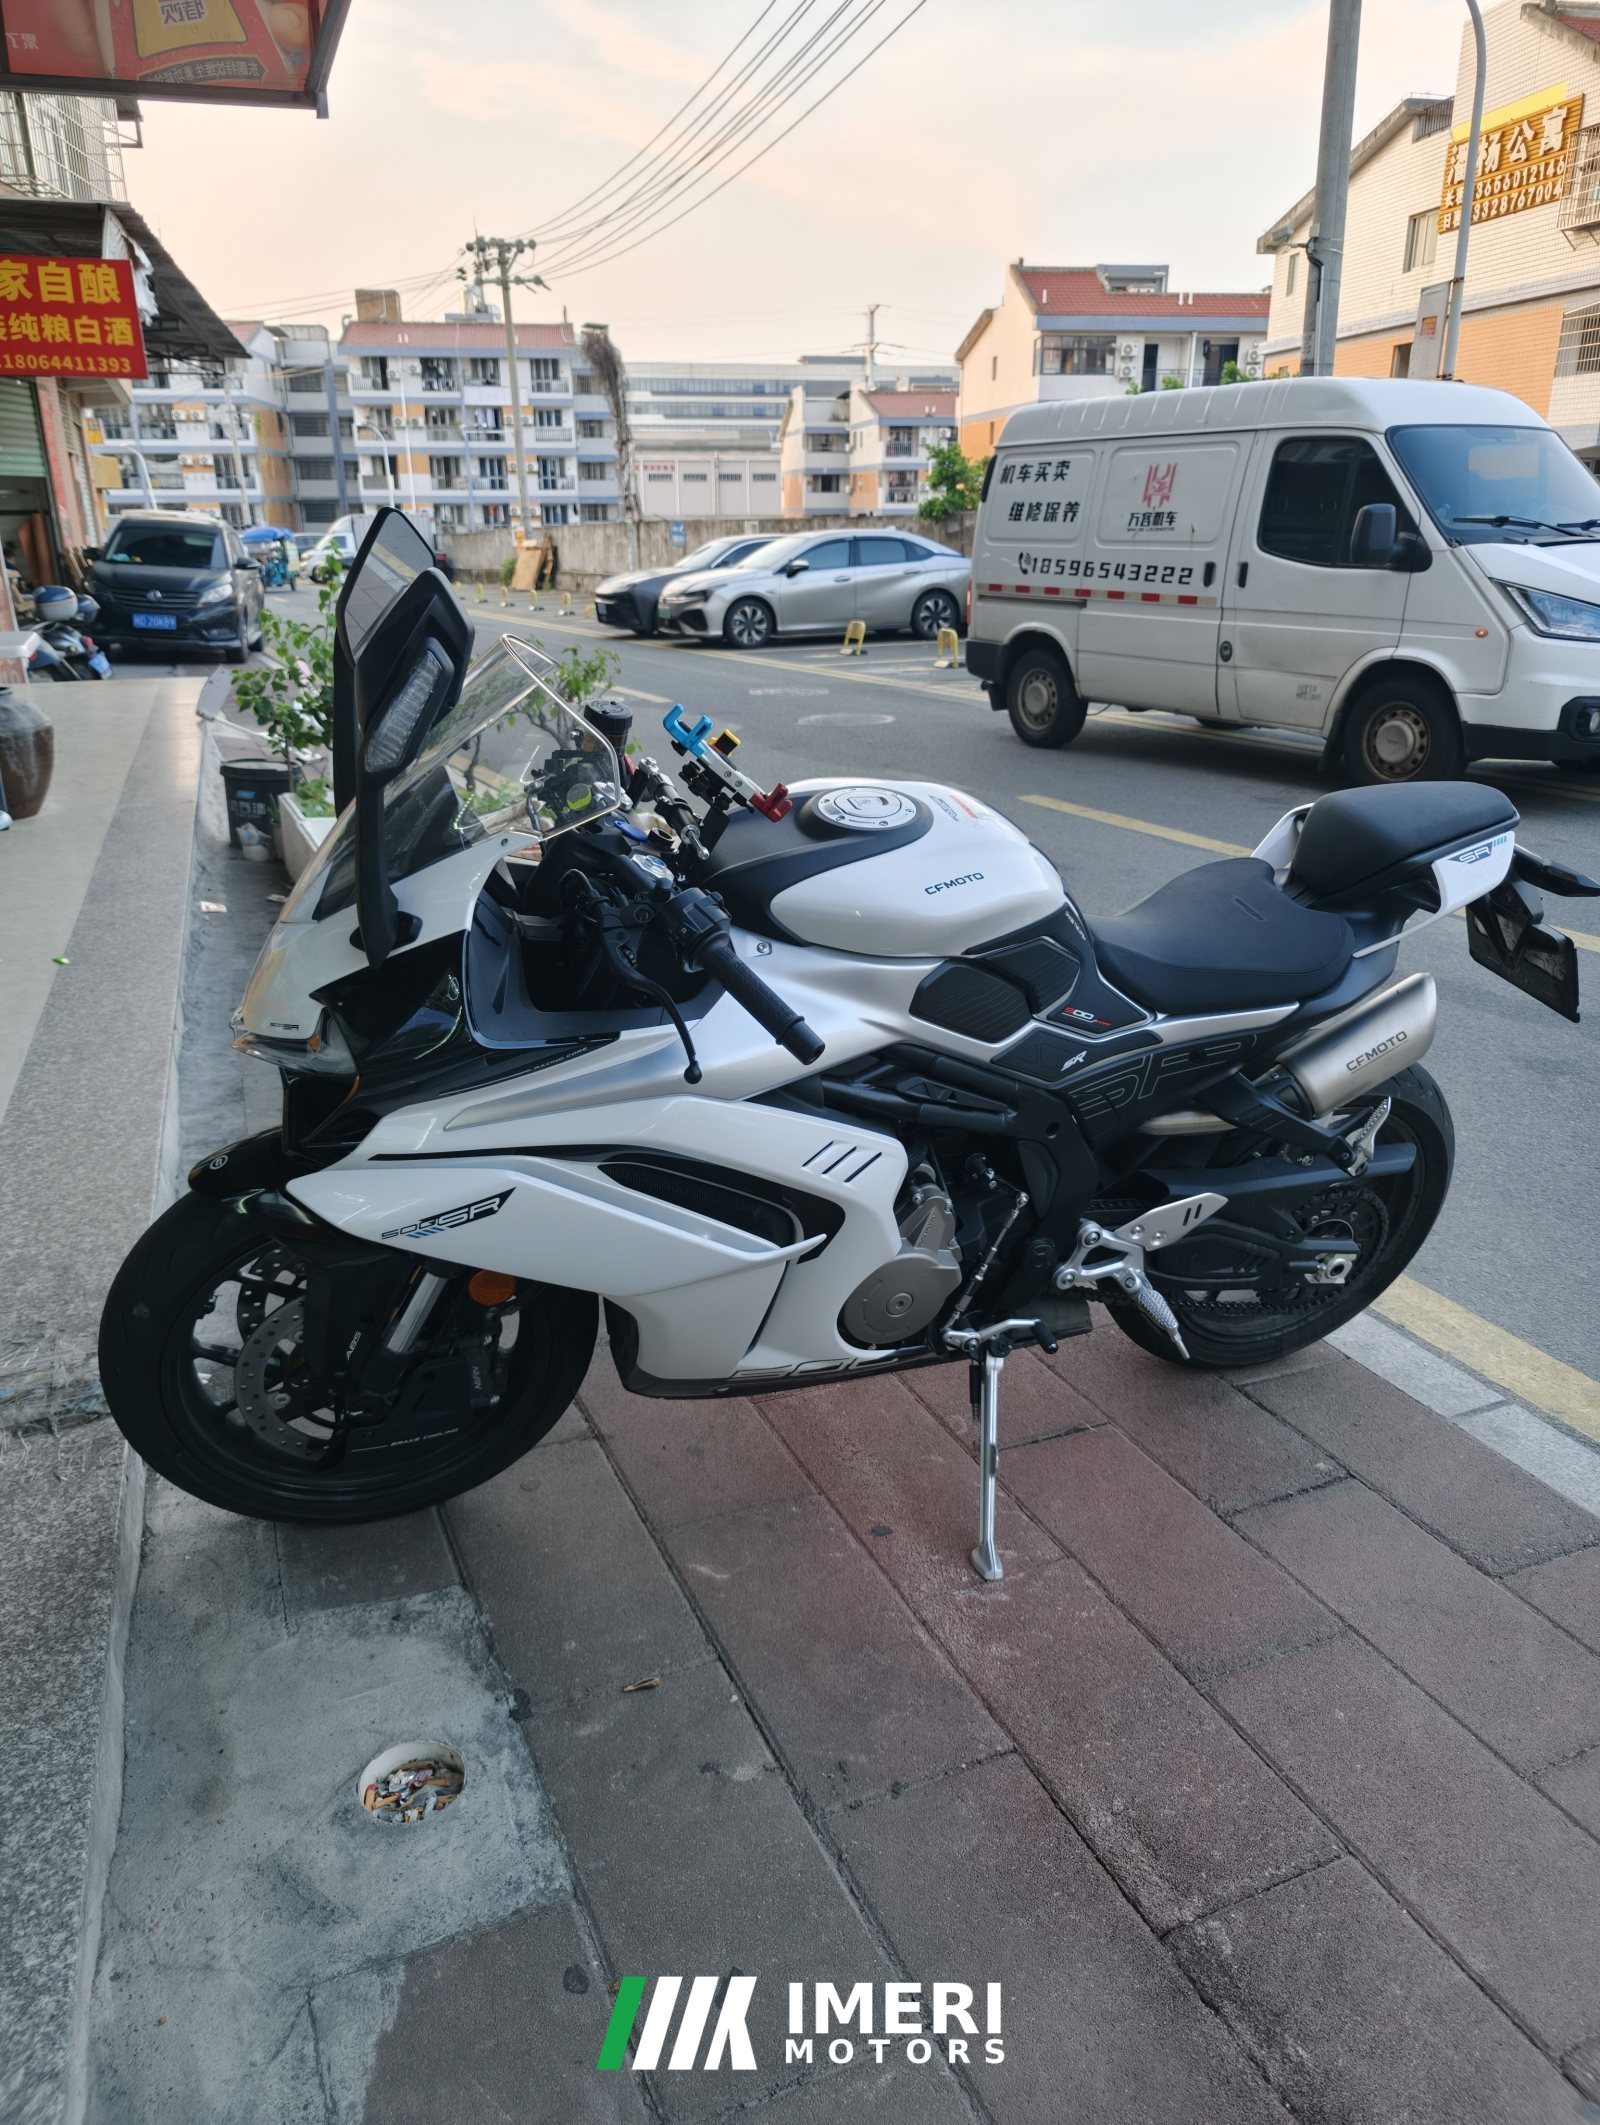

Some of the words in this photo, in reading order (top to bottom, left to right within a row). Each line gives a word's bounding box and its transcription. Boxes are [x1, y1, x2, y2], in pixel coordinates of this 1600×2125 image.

[1475, 154, 1566, 200] 3656012146
[1473, 178, 1562, 221] 3328767004
[0, 259, 121, 304] 家自酿
[3, 354, 132, 373] 18064411393
[1000, 460, 1071, 485] 机车买卖
[1008, 501, 1081, 523] 维修保养
[1032, 558, 1194, 585] 18596543222
[1458, 847, 1491, 864] SR
[924, 871, 984, 895] CFMOTO
[533, 1055, 565, 1071] RACING
[565, 1046, 588, 1059] CORE
[1346, 1030, 1408, 1073] CFMOTO
[346, 1330, 362, 1361] ABS
